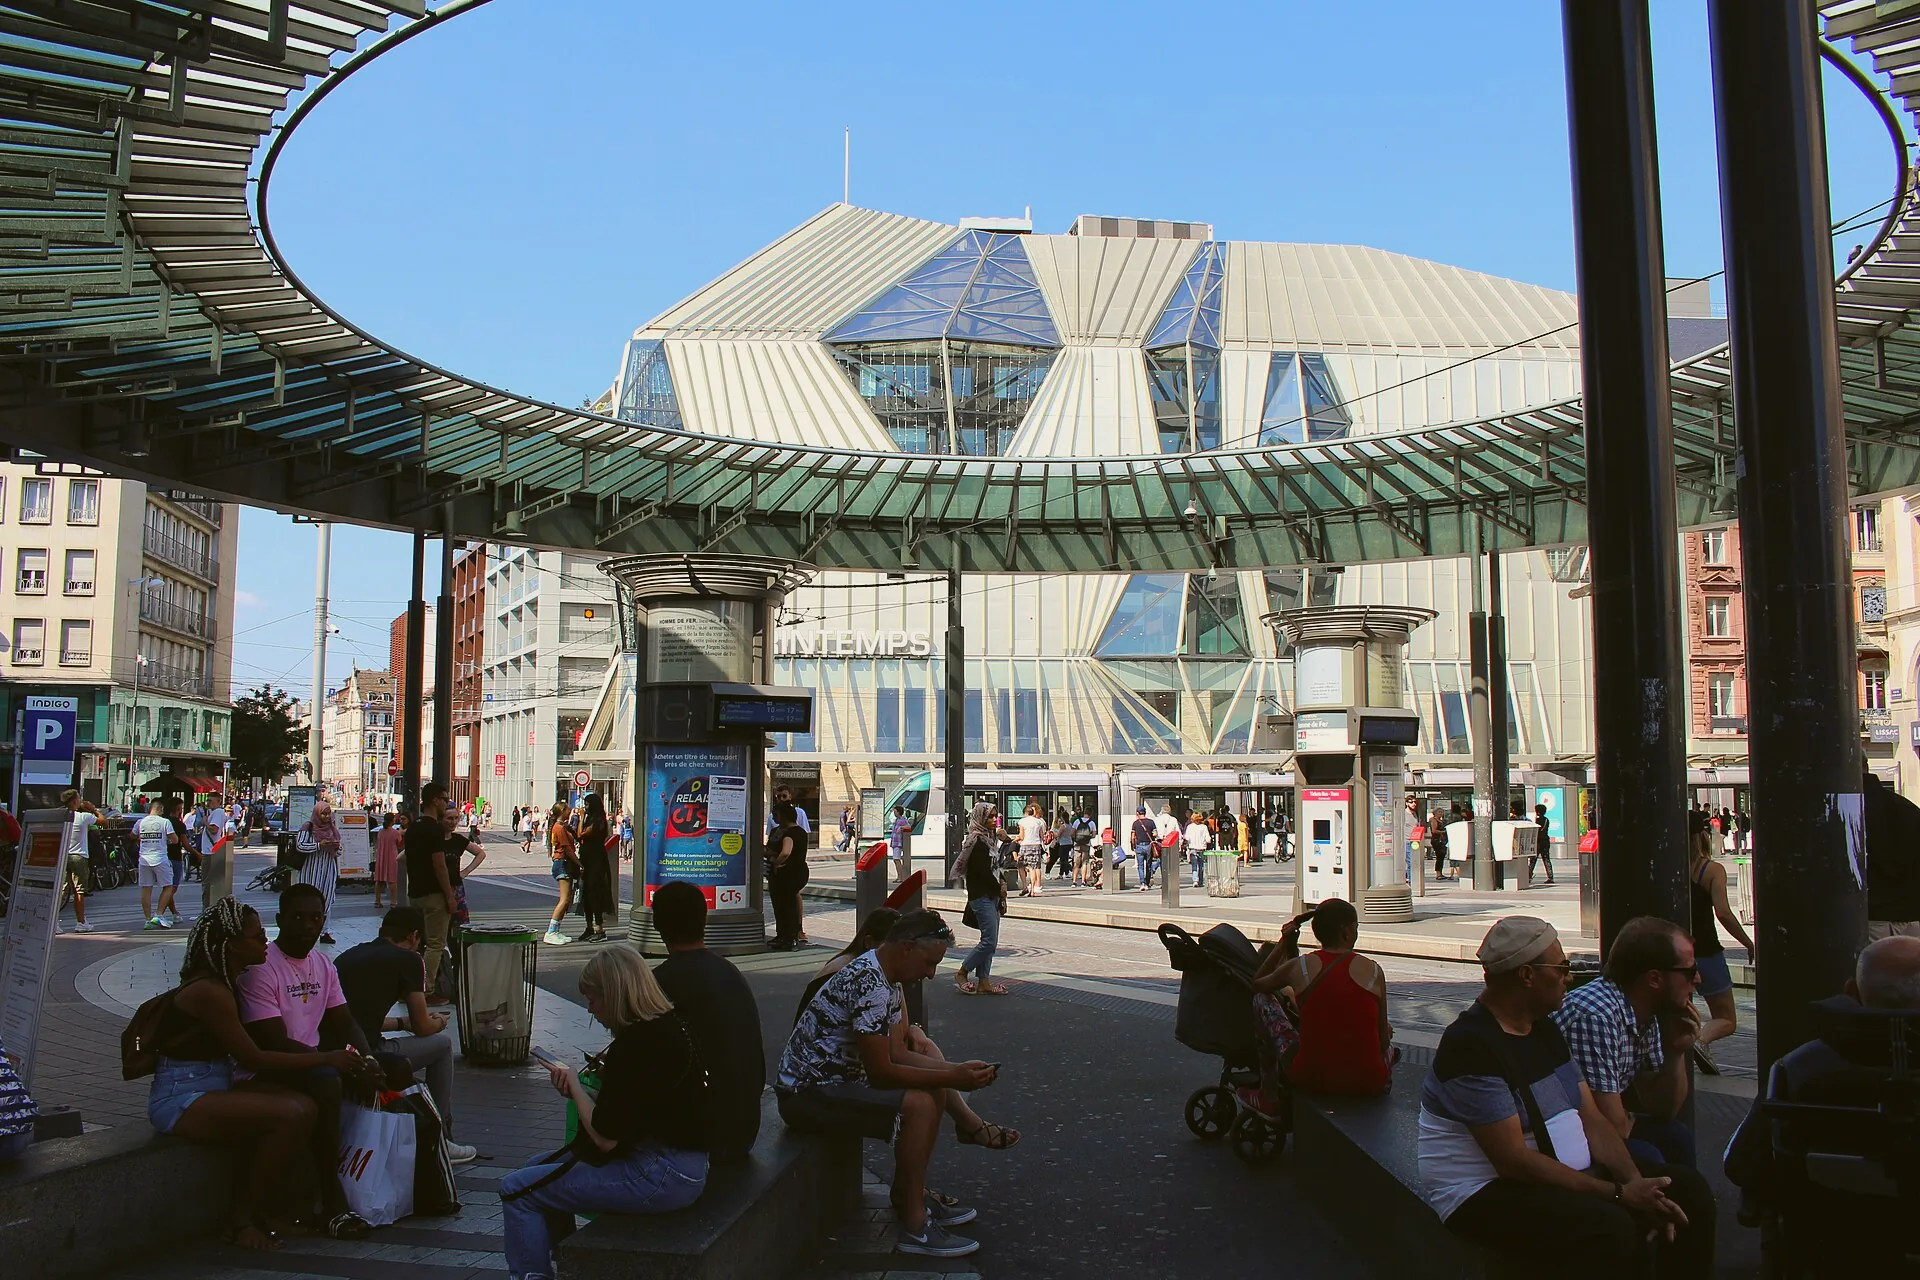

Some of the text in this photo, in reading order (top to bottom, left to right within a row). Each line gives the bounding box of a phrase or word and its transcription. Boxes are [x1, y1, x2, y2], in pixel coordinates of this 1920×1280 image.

[33, 699, 70, 708] INDIGO
[36, 718, 63, 750] P
[694, 859, 728, 867] recharger
[720, 889, 742, 903] CTS
[306, 981, 321, 990] Park
